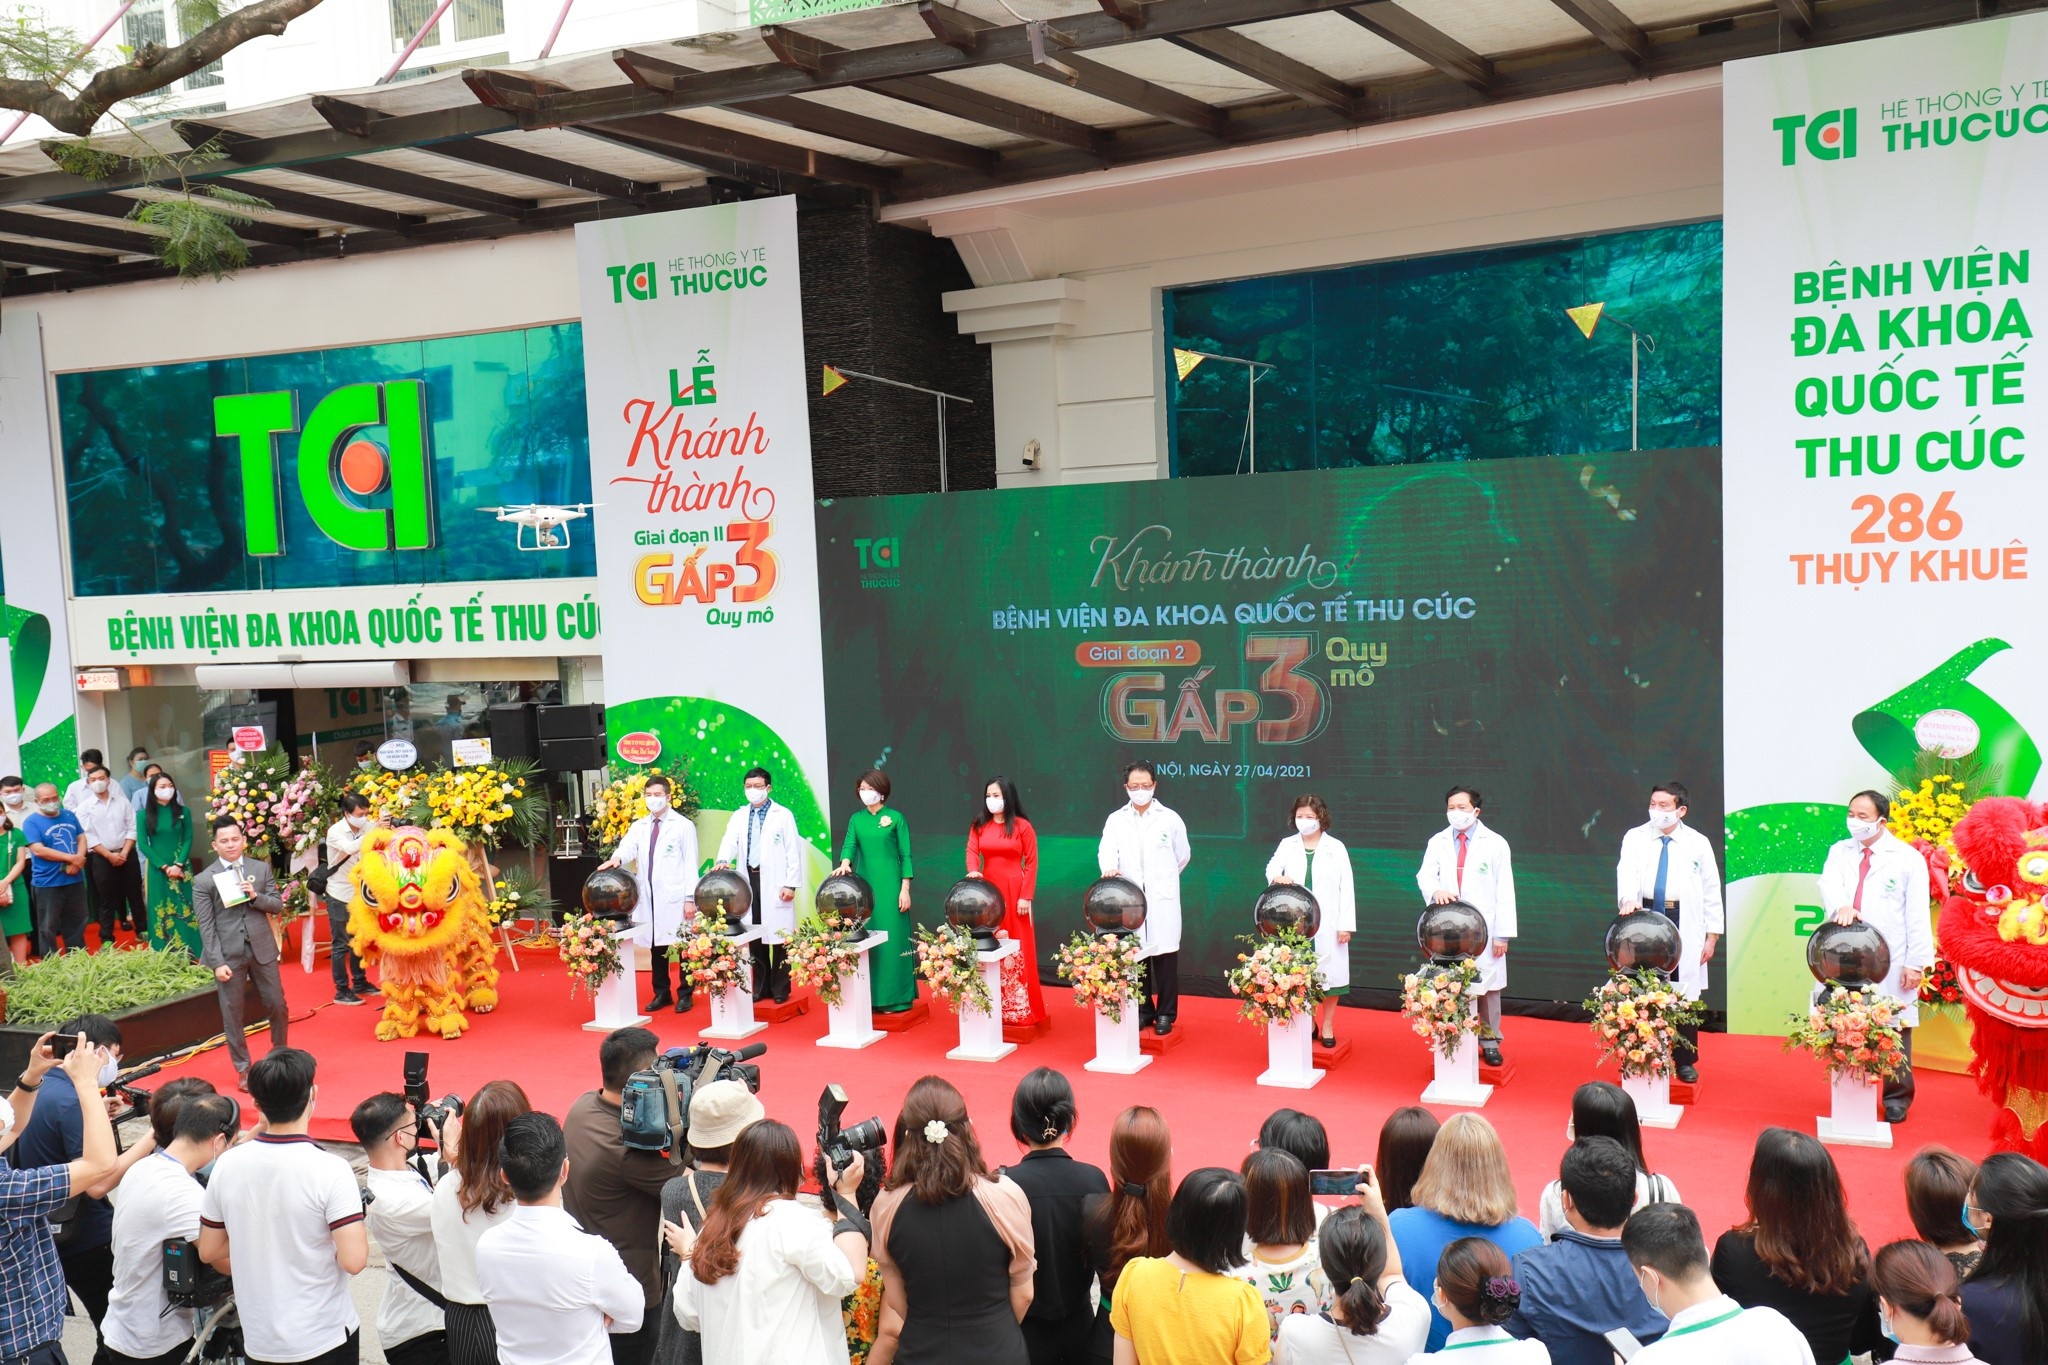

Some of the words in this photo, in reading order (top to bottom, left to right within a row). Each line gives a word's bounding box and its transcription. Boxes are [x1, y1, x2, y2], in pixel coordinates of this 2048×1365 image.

[2010, 83, 2025, 101] Y
[1773, 107, 1857, 166] TCI
[606, 262, 657, 303] TCI
[740, 249, 749, 263] Y
[1794, 260, 1912, 309] BỆNH
[1922, 245, 2029, 296] VIỆN
[1791, 312, 1865, 357] ĐA
[1878, 298, 2033, 350] KHOA
[669, 349, 717, 407] LỄ
[1794, 352, 1940, 418] QUỐC
[1955, 342, 2029, 407] TẾ
[623, 397, 770, 470] Khánh
[1795, 434, 1900, 478] THU
[1915, 414, 2025, 472] CÚC
[213, 379, 435, 556] TCI
[609, 465, 775, 522] thành
[634, 529, 665, 546] Giai
[669, 528, 710, 547] đoạn
[1850, 491, 1963, 544] 286
[633, 546, 736, 607] GẤP
[727, 518, 779, 605] 3
[853, 537, 901, 569] TCI
[1090, 525, 1216, 591] Khánh
[1186, 544, 1337, 589] thành
[1789, 551, 1900, 591] THỤY
[1910, 538, 2028, 582] KHUÊ
[107, 609, 175, 657] BỆNH
[180, 607, 240, 656] VIỆN
[245, 612, 283, 647] ĐA
[288, 609, 361, 647] KHOA
[368, 592, 443, 648] QUỐC
[450, 591, 485, 642] TẾ
[491, 604, 548, 642] THU
[556, 593, 602, 640] CÚ
[706, 607, 742, 628] Quy
[747, 606, 774, 623] mô
[992, 604, 1050, 635] BỆNH
[1056, 602, 1107, 634] VIỆN
[1113, 606, 1149, 627] ĐA
[1156, 604, 1229, 626] KHOA
[1234, 593, 1316, 625] QUỐC
[1322, 590, 1353, 622] TẾ
[1354, 599, 1404, 621] THU
[1412, 591, 1477, 620] CÚC
[1089, 646, 1122, 661] Giai
[1126, 645, 1170, 664] đoạn
[1174, 645, 1185, 659] 2
[1325, 637, 1388, 667] Quy
[1330, 663, 1375, 686] mô
[1103, 665, 1261, 743] GẤP
[1246, 633, 1328, 745] 3
[1156, 761, 1186, 778] NỘI,
[1190, 760, 1231, 776] NGÀY
[1235, 764, 1312, 779] 27/04/2021
